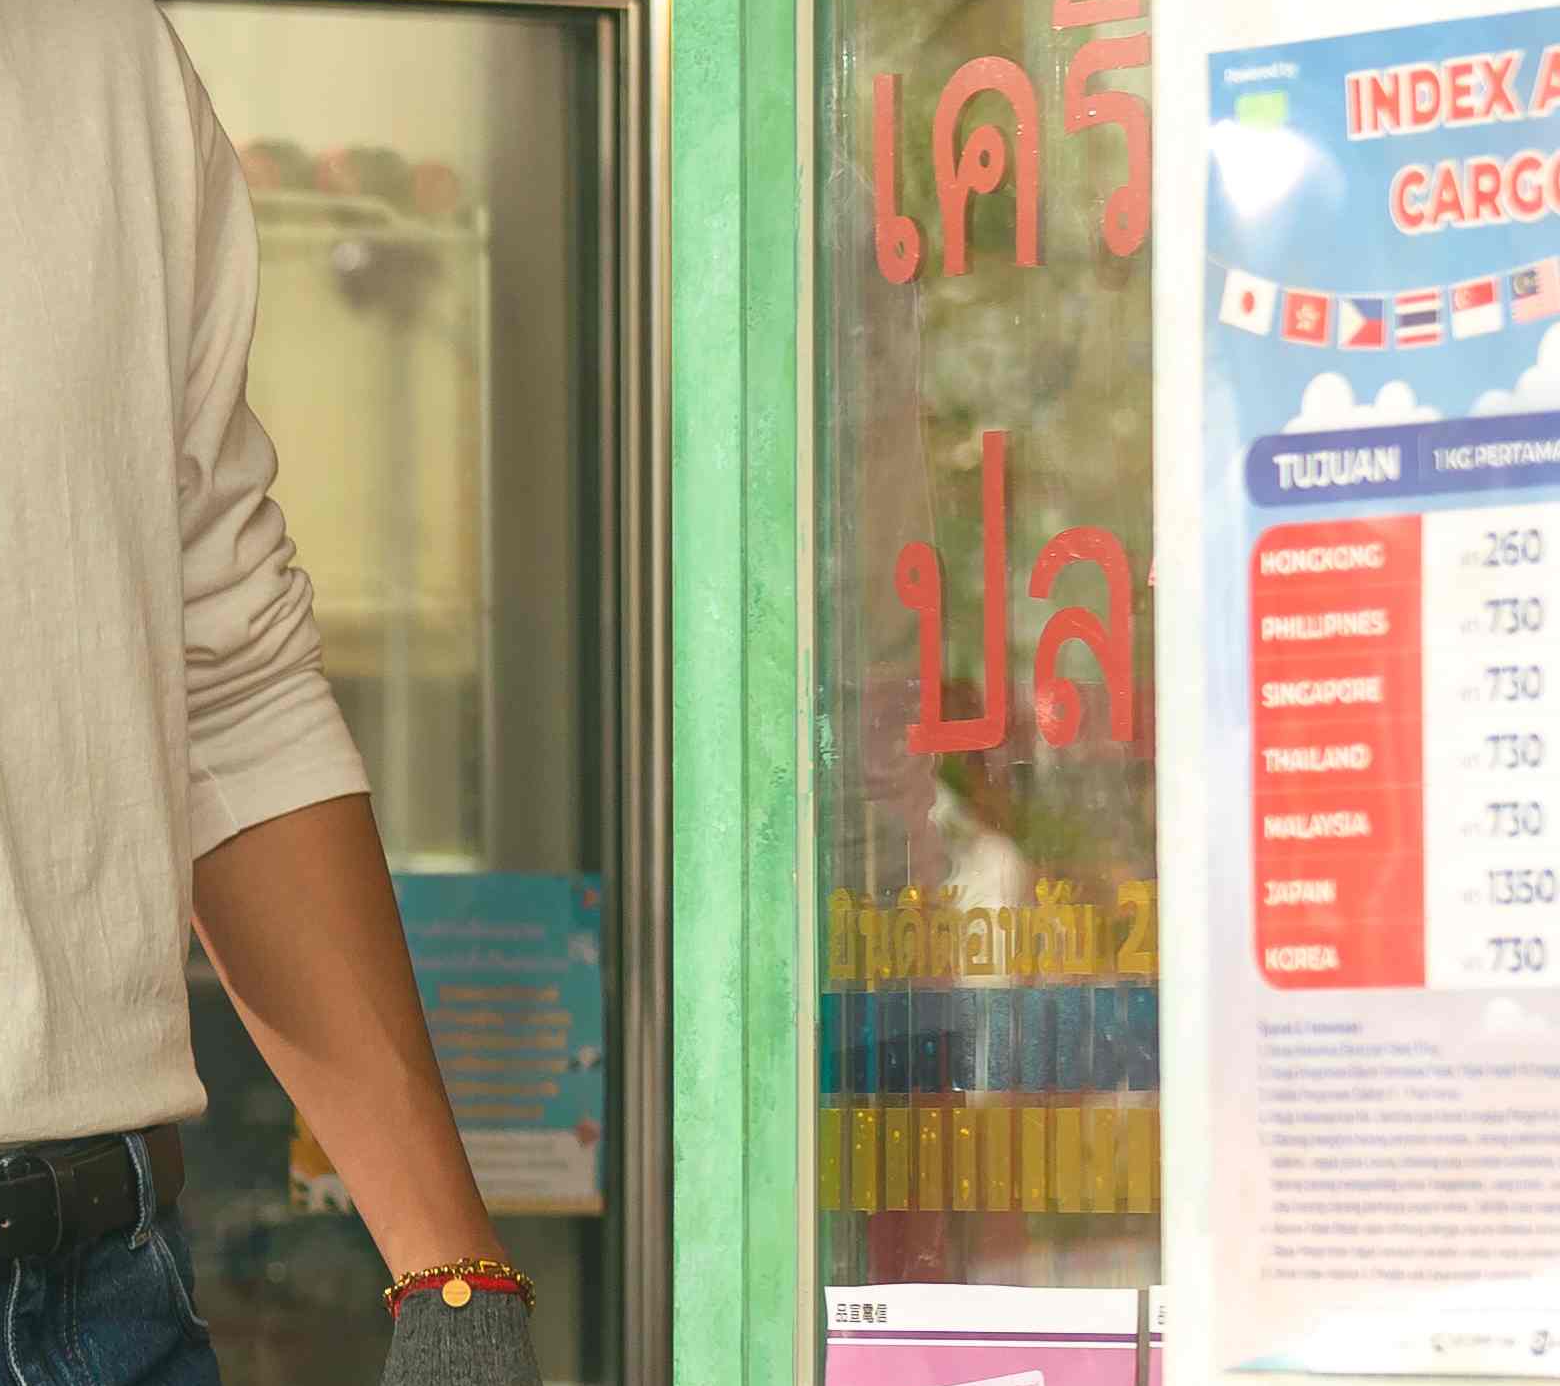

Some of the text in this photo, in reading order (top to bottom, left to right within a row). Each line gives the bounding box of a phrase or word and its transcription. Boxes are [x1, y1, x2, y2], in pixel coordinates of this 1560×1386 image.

[1346, 51, 1522, 139] INDEX
[1272, 445, 1401, 489] TUJUAN
[1260, 542, 1385, 575] HONGKONG
[894, 430, 1154, 754] ปล
[1262, 676, 1383, 708] SINGAPORE
[1263, 743, 1372, 773] THAILAND
[1264, 810, 1370, 840] MALAYSIA
[1265, 880, 1337, 906] JAPAN
[1265, 945, 1340, 972] KOREA
